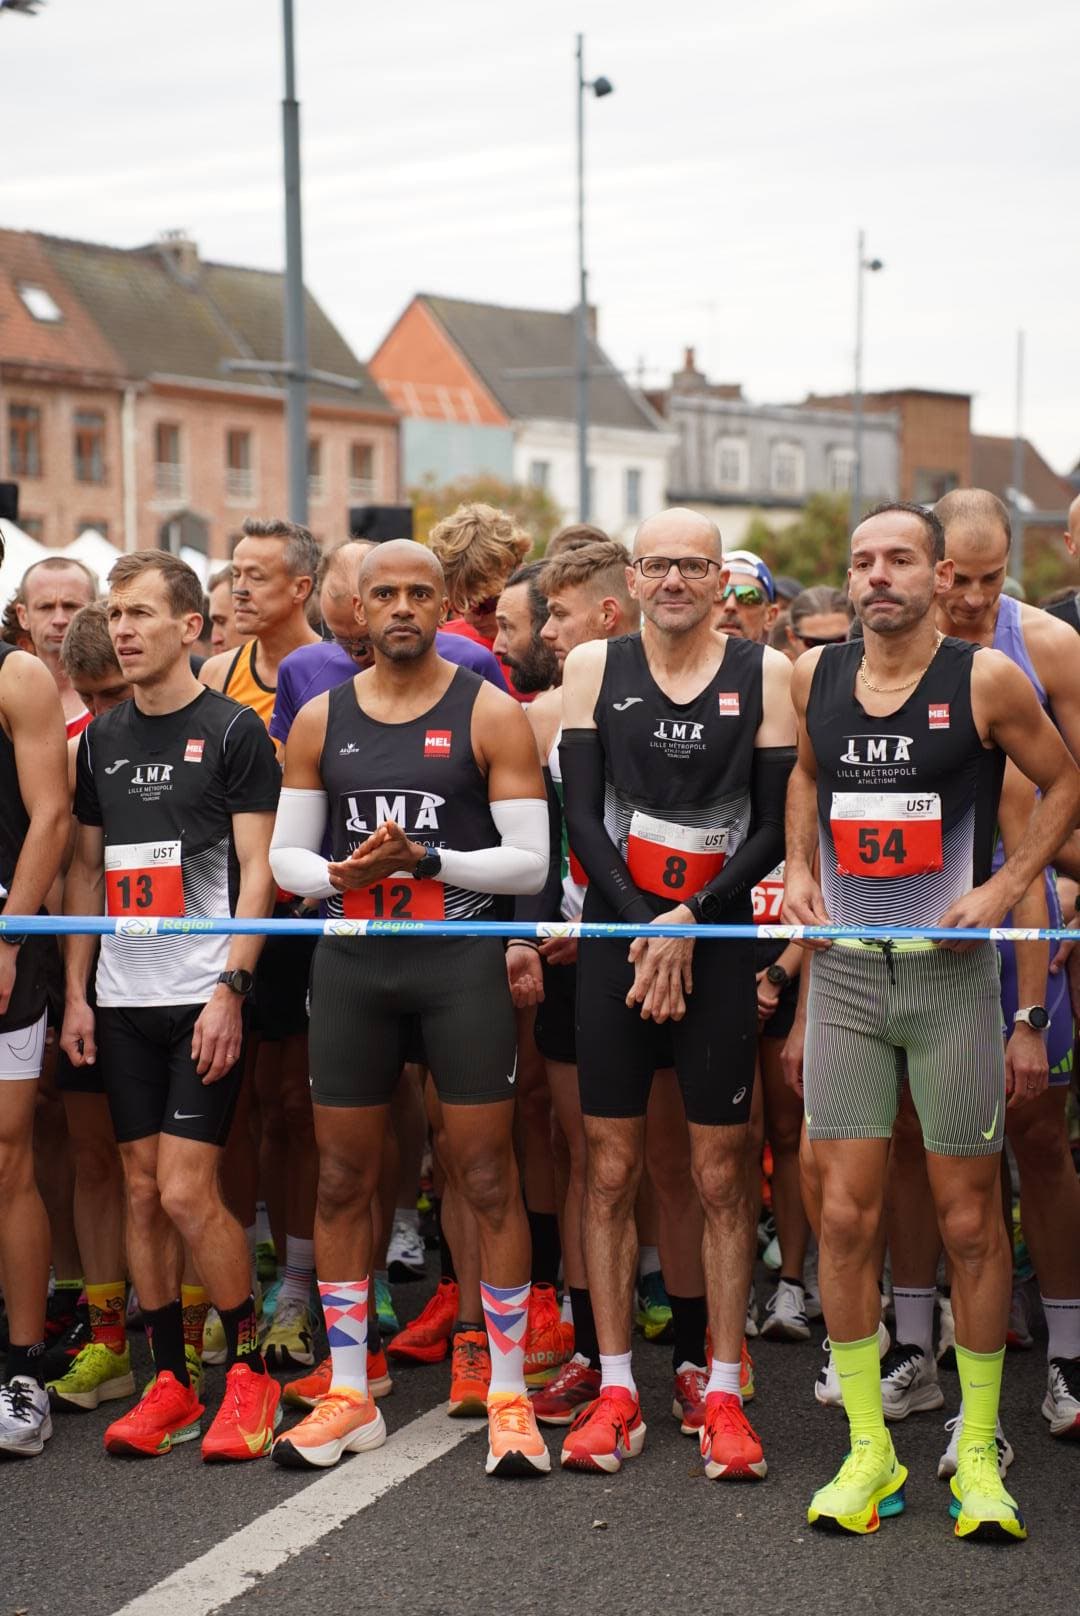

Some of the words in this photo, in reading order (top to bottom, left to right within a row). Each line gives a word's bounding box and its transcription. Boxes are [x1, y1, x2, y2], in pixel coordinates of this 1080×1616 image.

[719, 698, 739, 706] MEL
[928, 709, 950, 718] MEL
[657, 721, 703, 740] LMA
[424, 737, 451, 747] MEL
[185, 745, 203, 753] MEL
[846, 738, 911, 762] LMA
[135, 766, 172, 783] LMA
[836, 769, 860, 778] LILLE
[863, 767, 917, 777] MÉTROPOLE
[857, 777, 897, 785] ATHLÉTISME
[128, 787, 142, 795] LILLE
[906, 799, 934, 812] UST
[345, 795, 440, 831] LMA
[705, 834, 725, 846] UST
[858, 828, 907, 864] 54
[153, 847, 175, 859] UST
[662, 855, 687, 889] 8
[116, 874, 153, 909] 13
[368, 883, 413, 918] 12
[751, 886, 784, 917] 67
